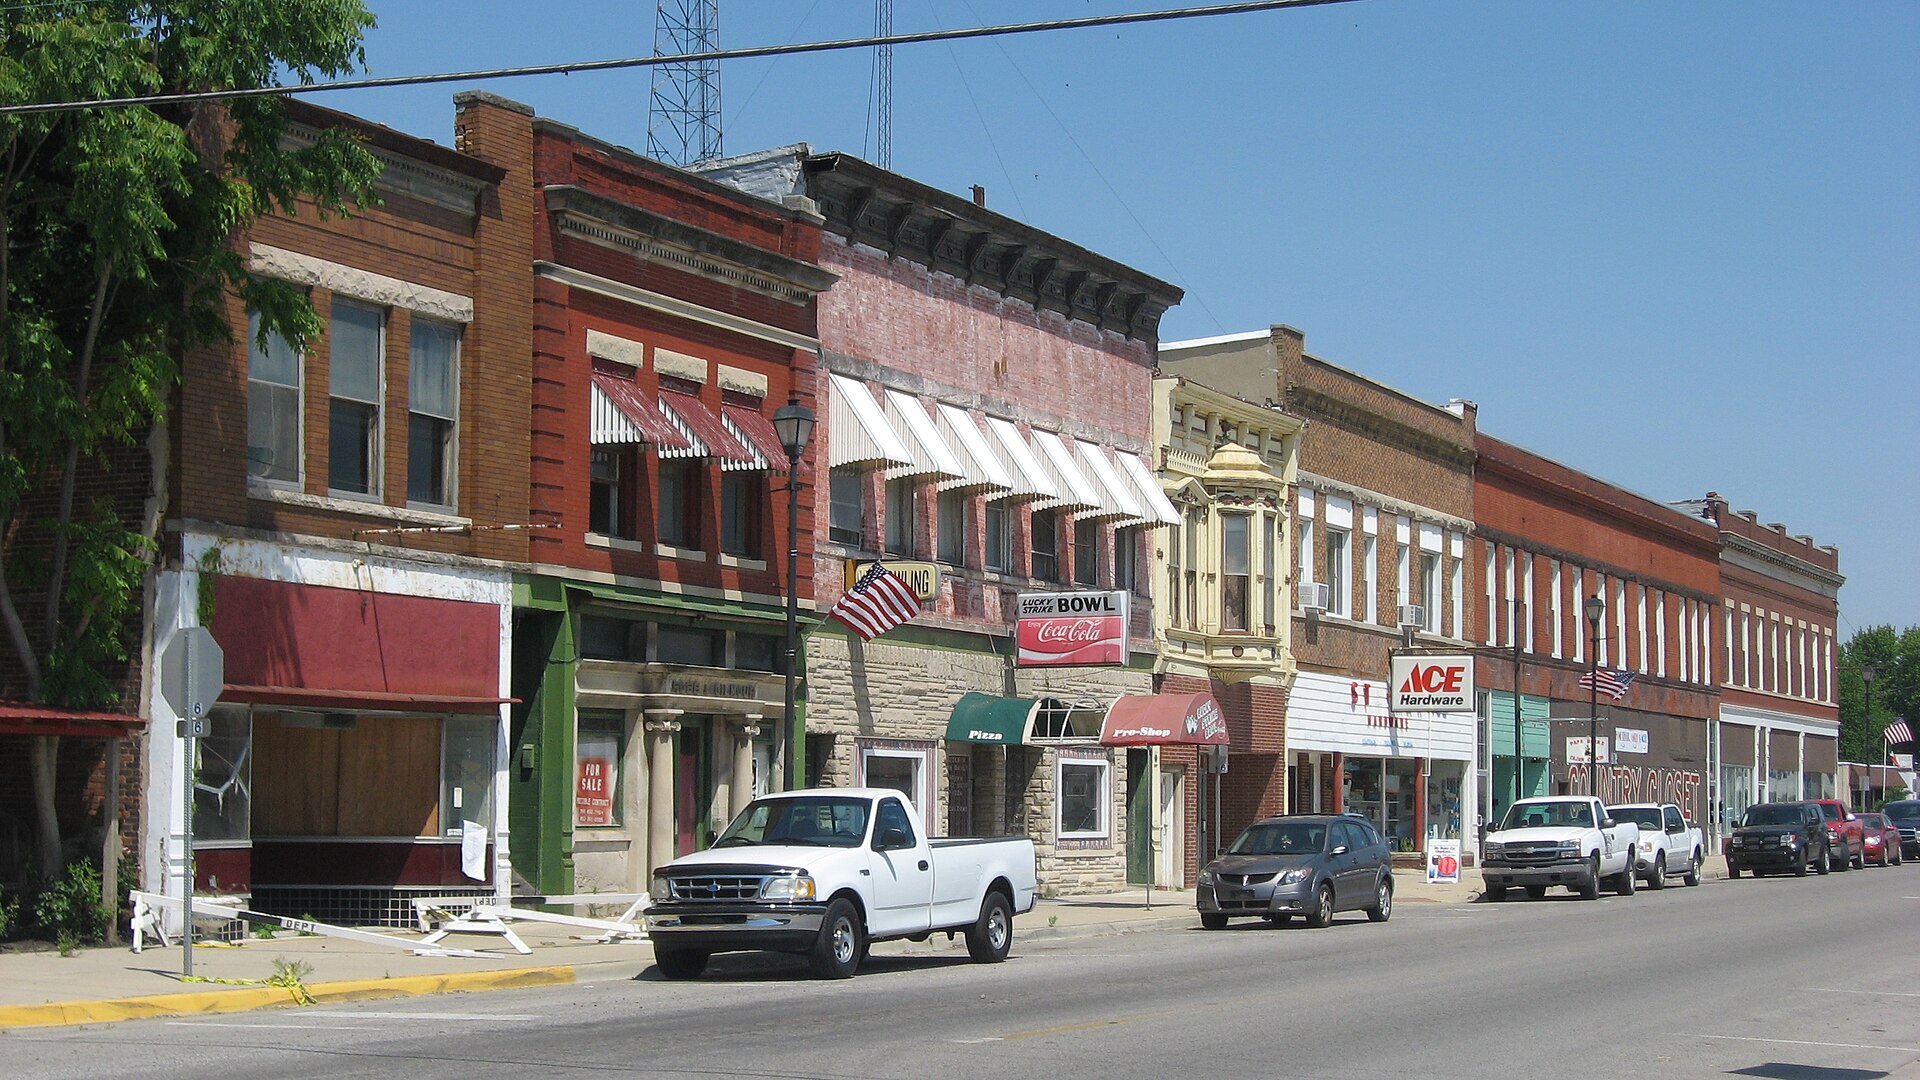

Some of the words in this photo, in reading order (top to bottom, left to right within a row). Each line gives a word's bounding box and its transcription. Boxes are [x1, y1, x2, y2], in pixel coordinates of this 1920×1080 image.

[1022, 598, 1053, 606] LUCKY
[1057, 596, 1115, 613] BOWL
[1022, 605, 1054, 614] STRIKE
[1038, 619, 1104, 643] Coca-Cola
[1399, 662, 1465, 693] ACE
[1400, 694, 1464, 706] Hardware
[194, 702, 201, 714] 6
[194, 721, 201, 733] 6
[1113, 727, 1171, 738] Pro-Shop
[968, 729, 1003, 741] Pizza
[585, 763, 600, 777] FOR
[581, 778, 603, 792] SALE
[286, 919, 317, 933] DEPT
